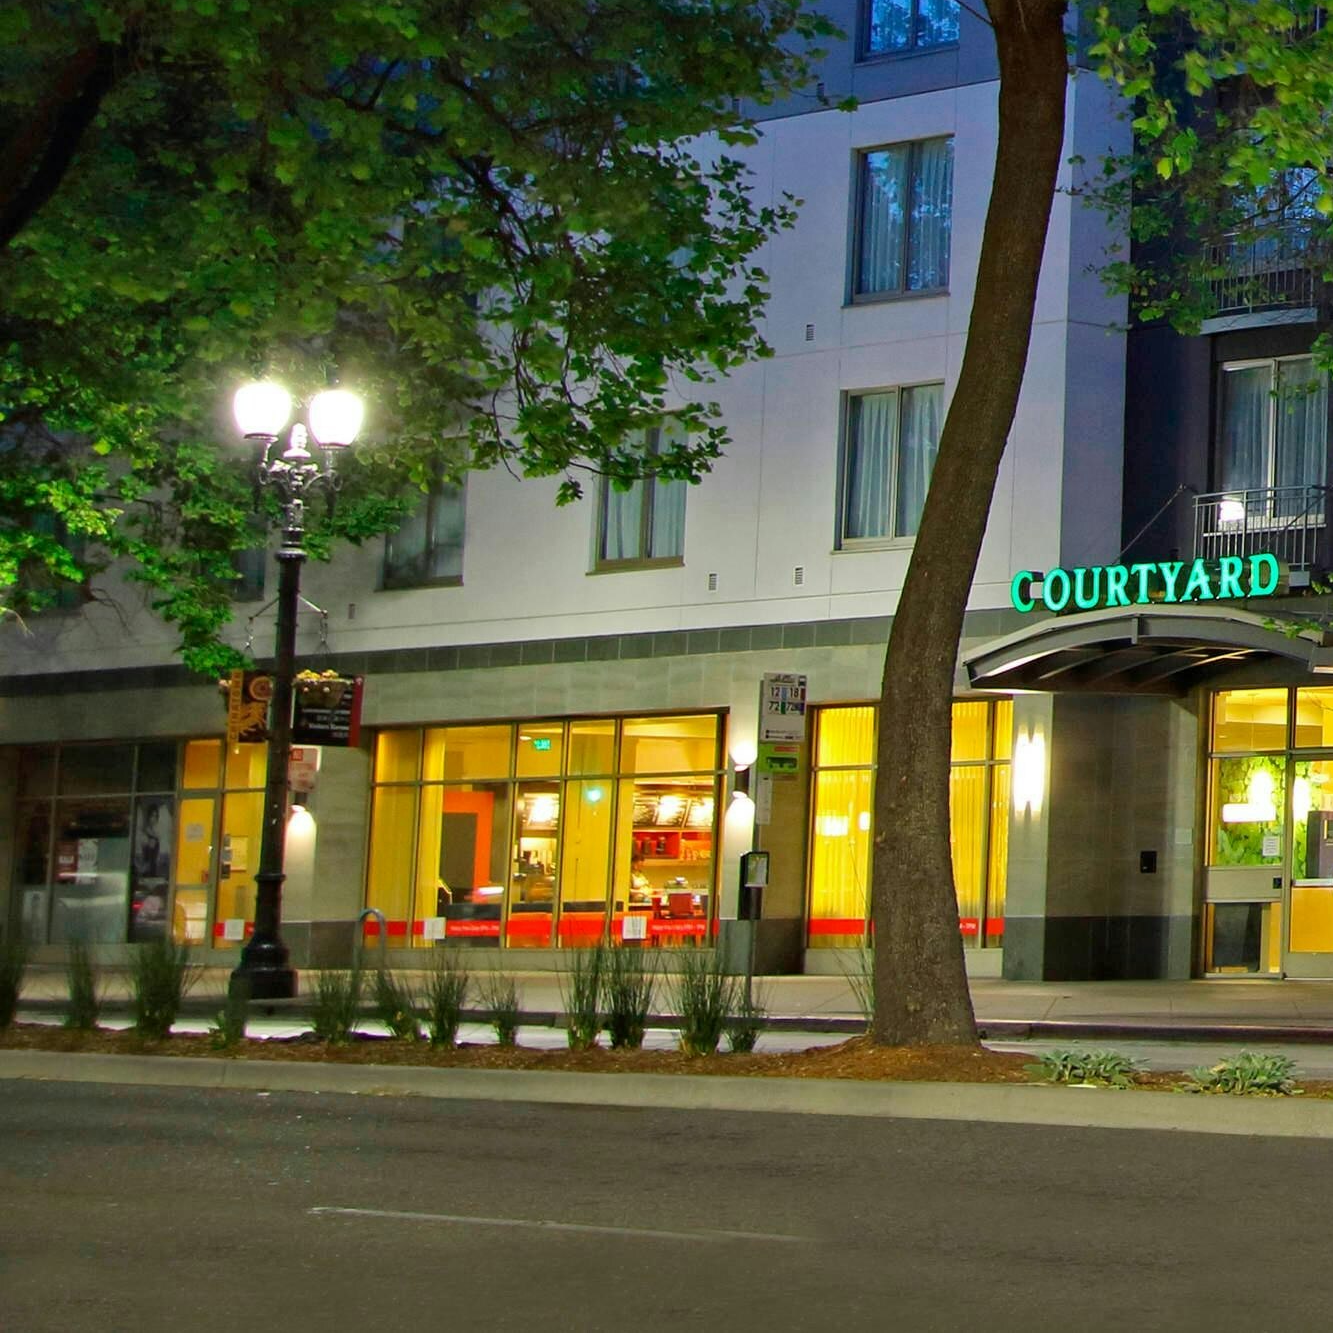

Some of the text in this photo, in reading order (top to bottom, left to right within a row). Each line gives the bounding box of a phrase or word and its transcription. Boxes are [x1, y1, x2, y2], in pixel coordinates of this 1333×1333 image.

[1010, 553, 1280, 613] COURTYARD
[770, 686, 800, 699] 12 18
